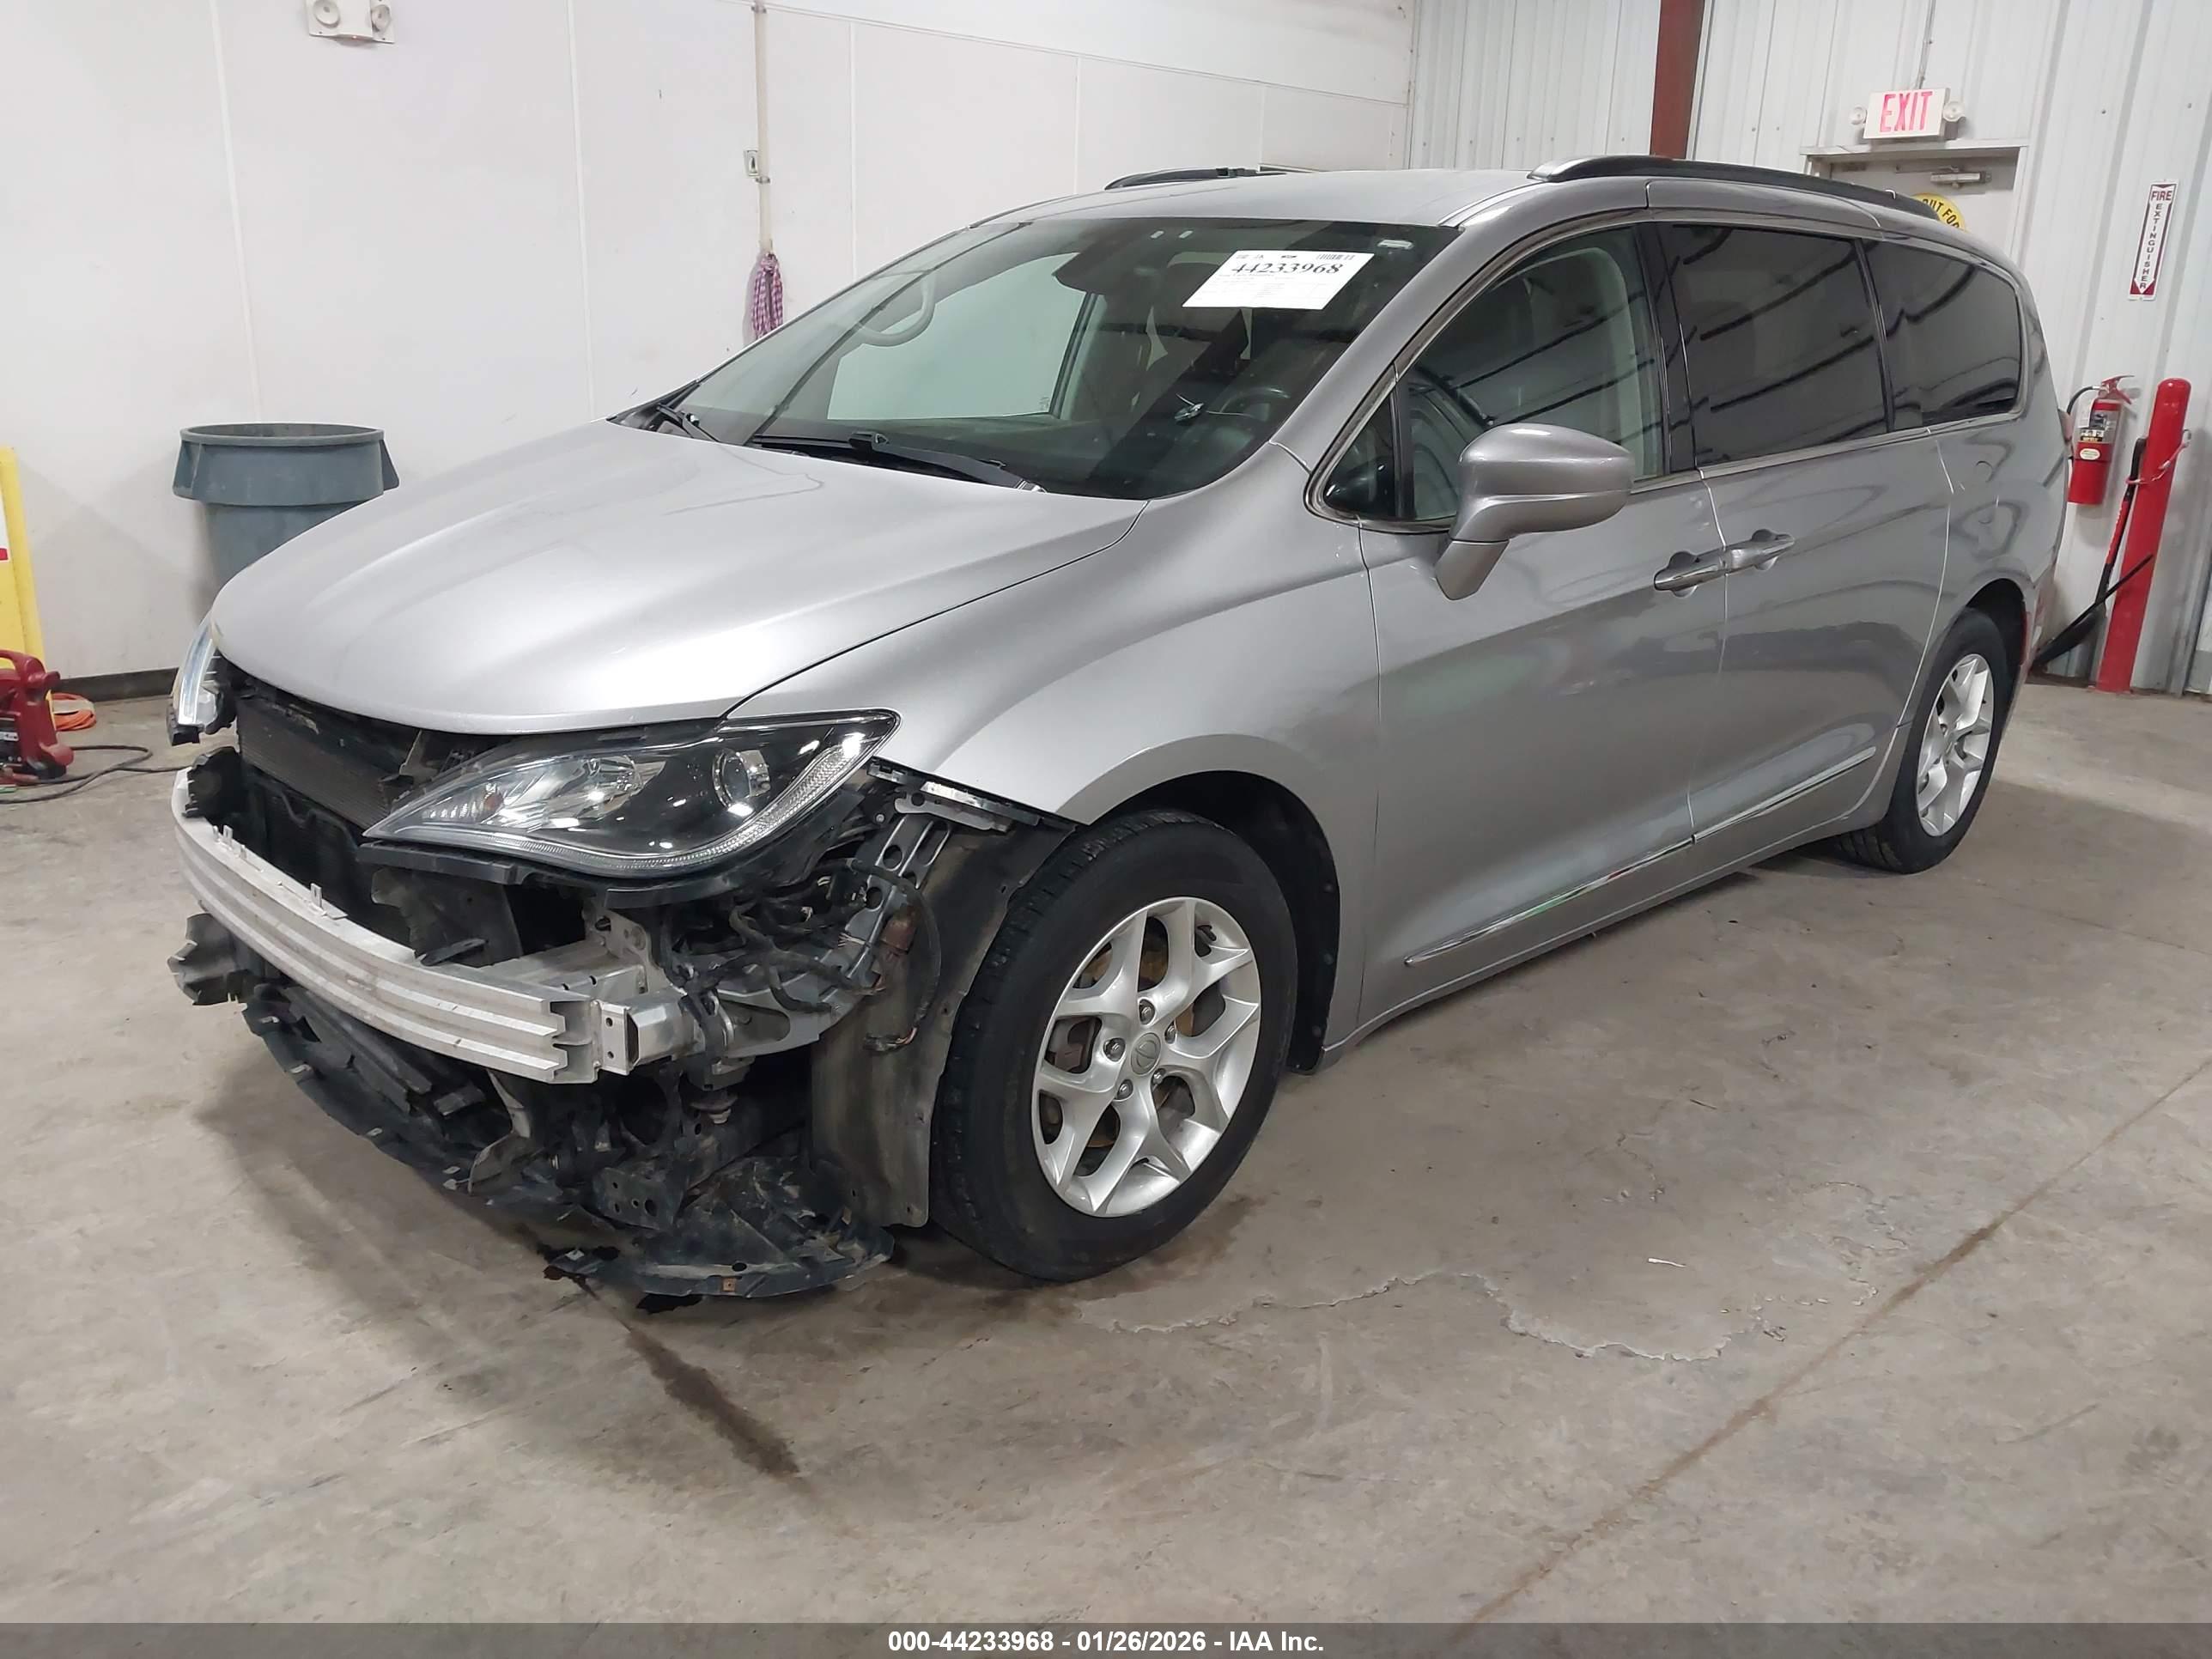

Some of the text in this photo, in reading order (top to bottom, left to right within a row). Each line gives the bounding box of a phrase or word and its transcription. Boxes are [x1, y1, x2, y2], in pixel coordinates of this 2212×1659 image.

[1880, 91, 1933, 132] EXIT
[2150, 191, 2172, 201] FIRE
[2140, 203, 2163, 289] EXTINGUISHER
[1231, 263, 1344, 274] 44233968
